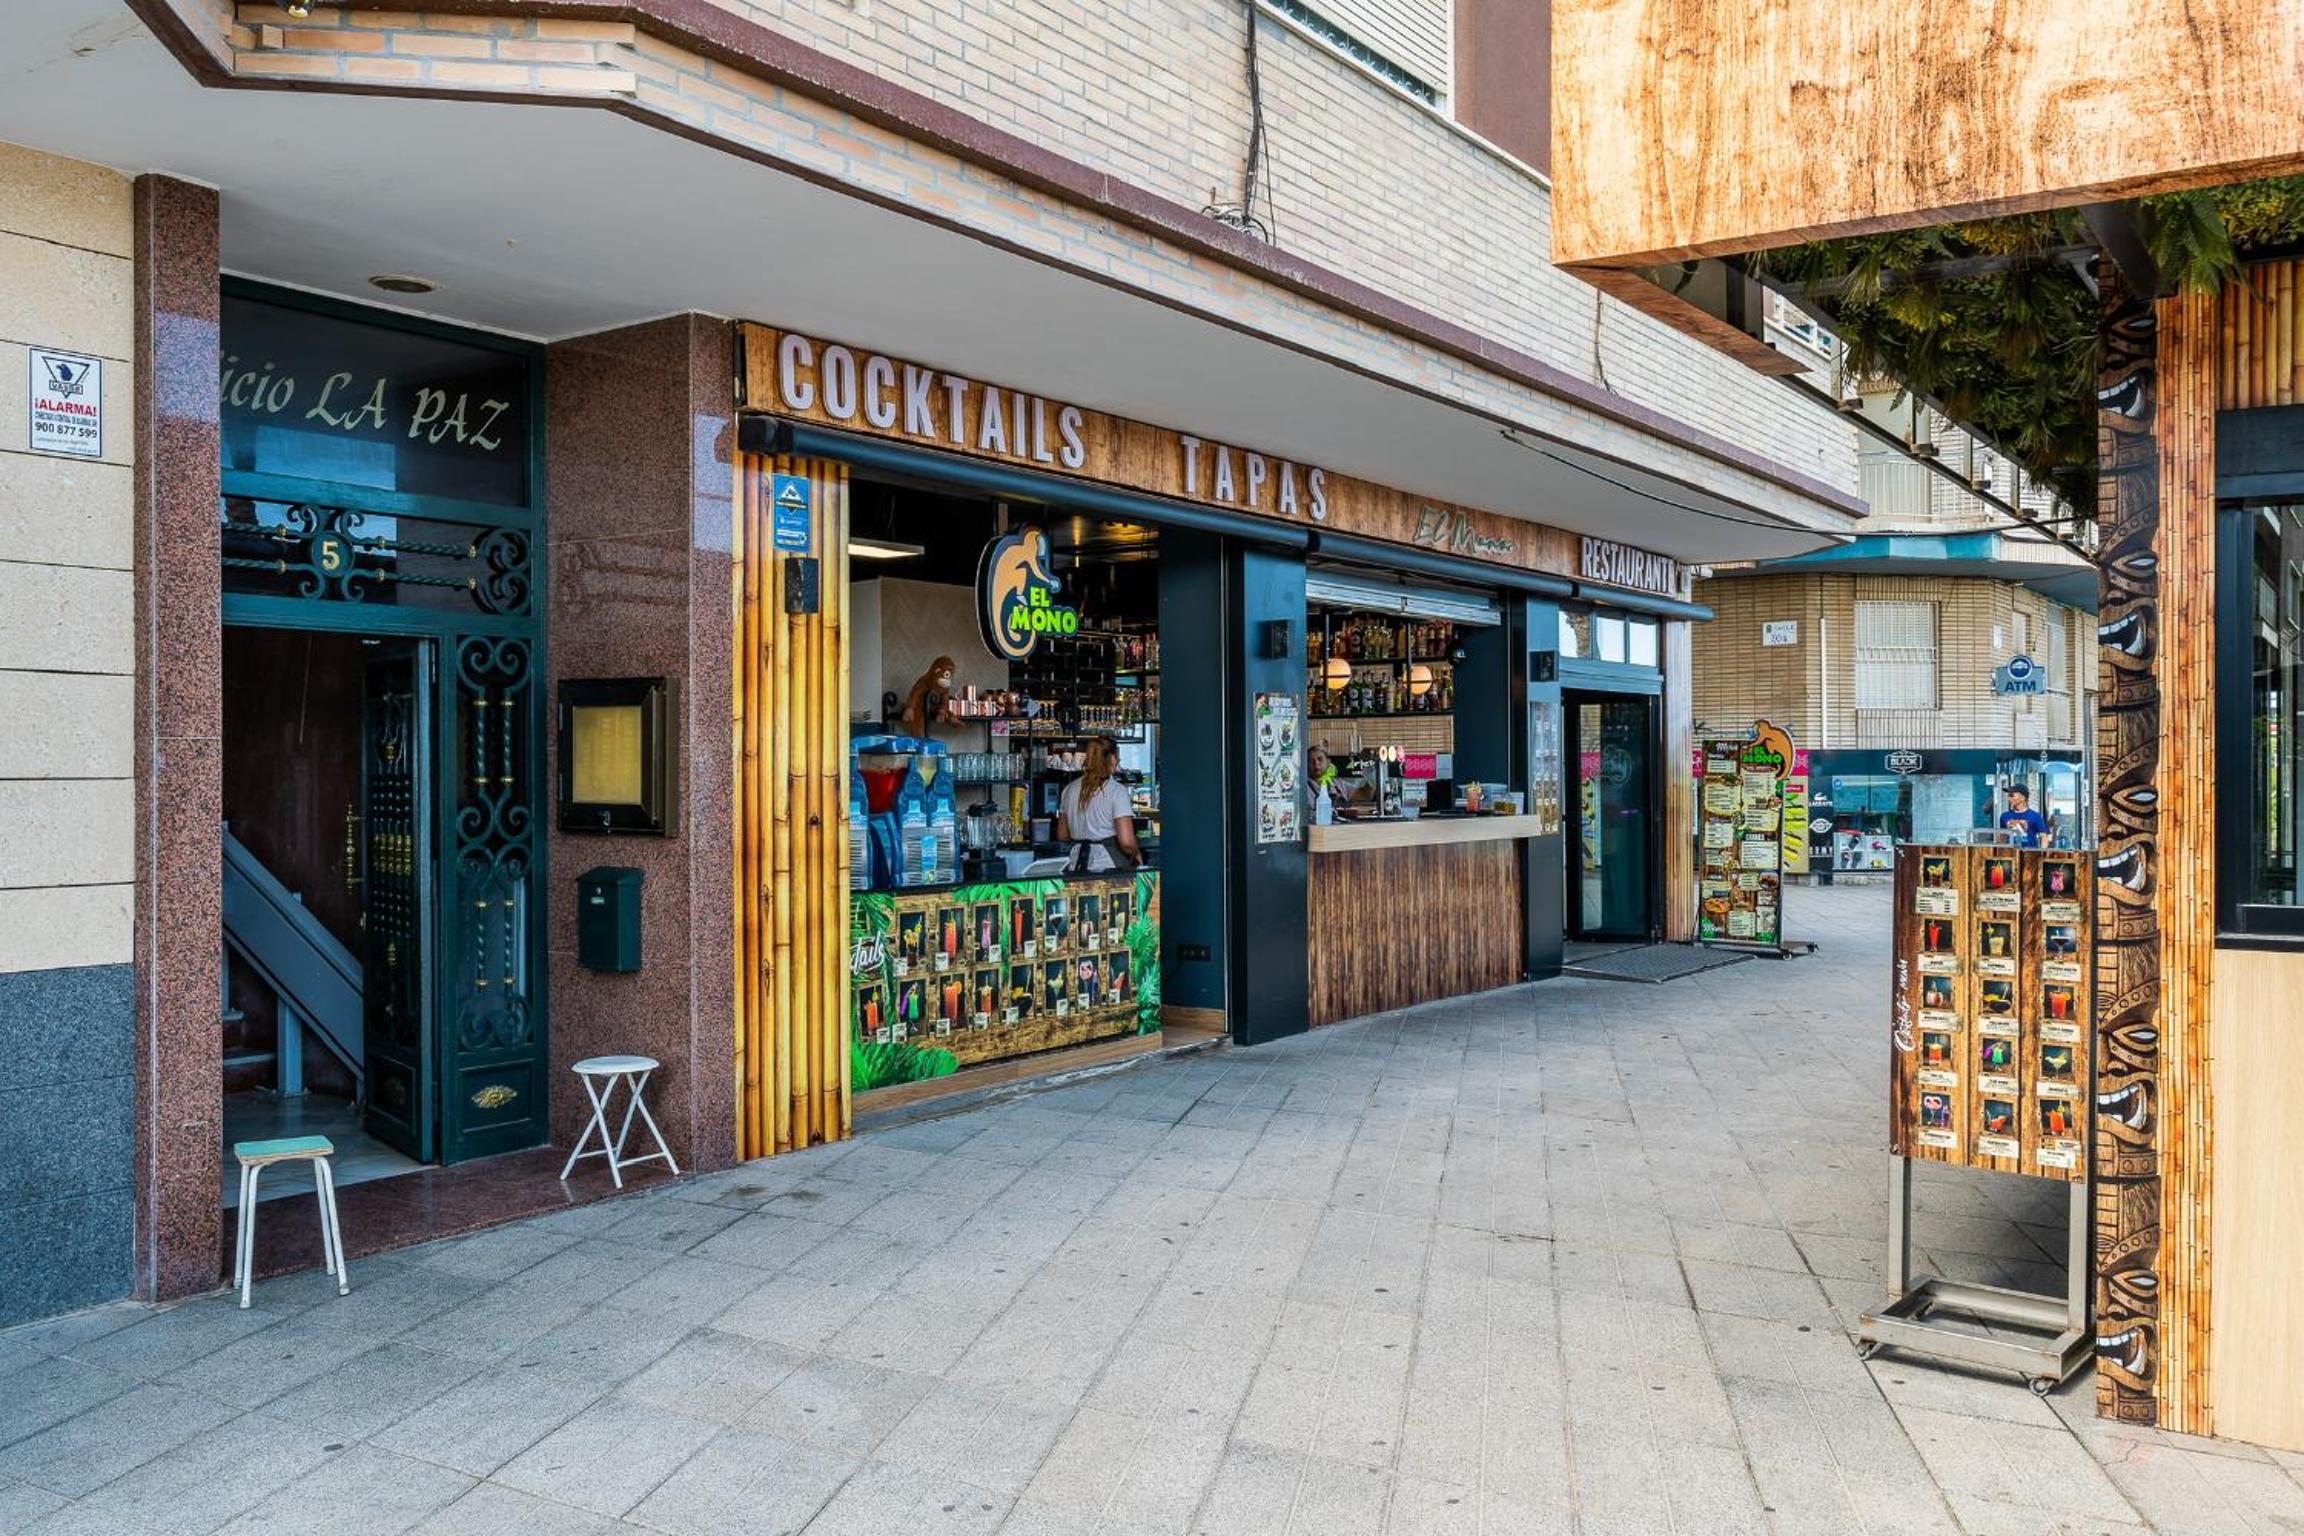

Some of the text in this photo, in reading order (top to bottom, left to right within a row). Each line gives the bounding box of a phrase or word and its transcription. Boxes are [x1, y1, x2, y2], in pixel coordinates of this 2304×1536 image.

[305, 372, 388, 430] LA
[407, 387, 510, 450] PAZ
[779, 334, 1086, 469] COCKTAILS
[35, 422, 98, 439] 900 877 599
[1181, 435, 1327, 521] TAPAS
[321, 541, 341, 570] 5
[1029, 586, 1051, 607] EL
[1010, 605, 1077, 633] MONO
[2004, 680, 2037, 693] ATM
[1743, 753, 1782, 763] MONO
[850, 930, 884, 976] tails
